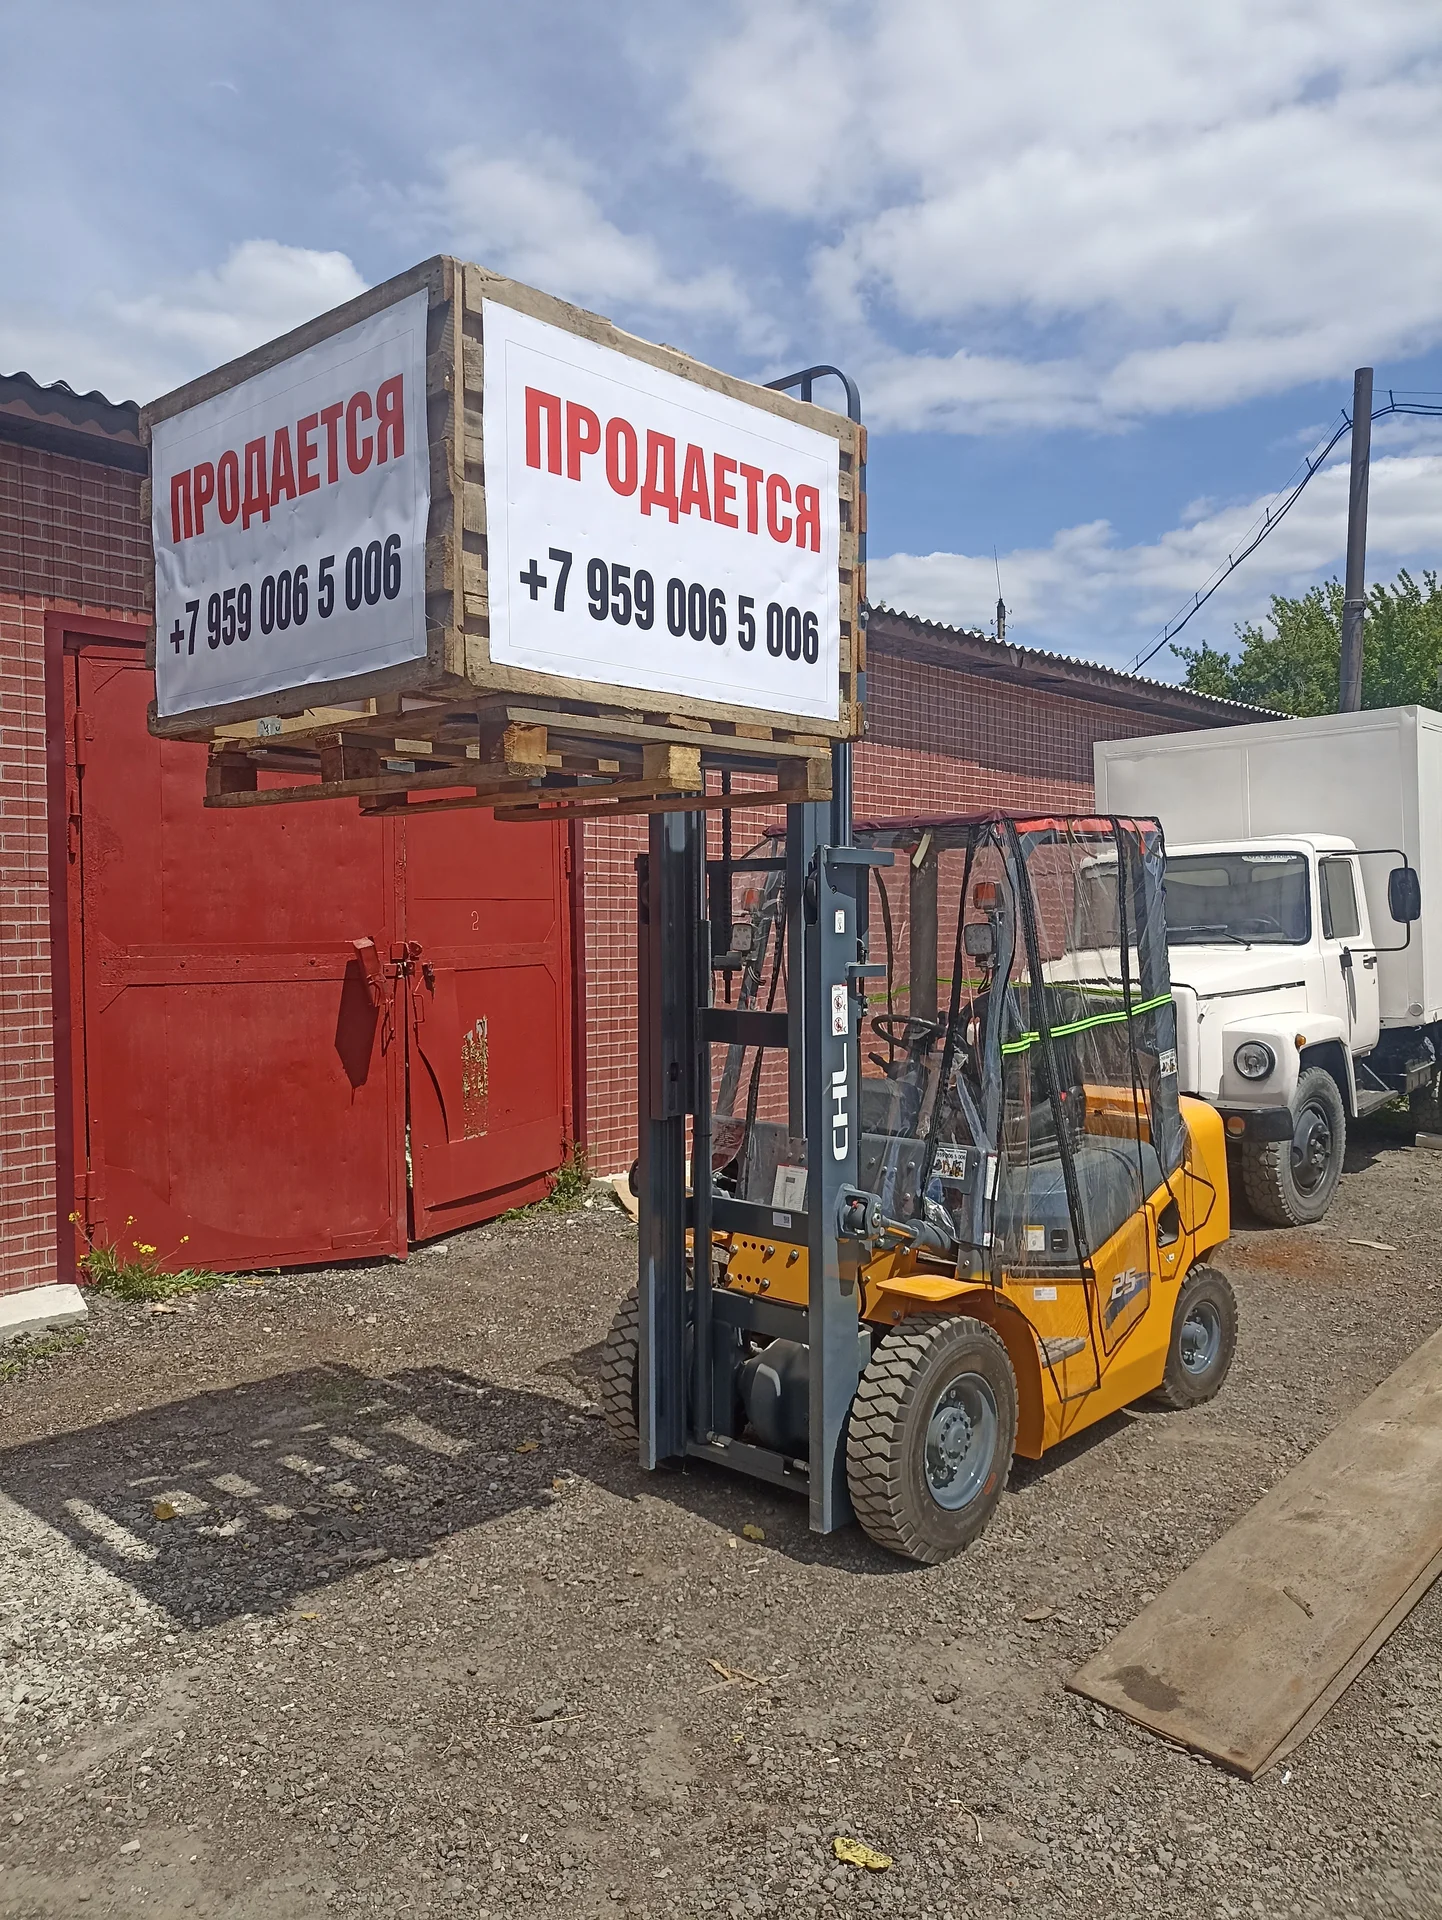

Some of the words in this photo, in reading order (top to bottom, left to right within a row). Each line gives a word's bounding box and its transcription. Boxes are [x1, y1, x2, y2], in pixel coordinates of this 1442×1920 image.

[171, 373, 404, 543] ПРОДАЕТСЯ
[525, 386, 820, 553] ПРОДАЕТСЯ
[170, 600, 200, 655] +7
[207, 582, 251, 650] 959
[260, 565, 307, 635] 006
[317, 555, 335, 619] 5
[345, 533, 401, 611] 006
[519, 547, 573, 612] +7
[587, 557, 654, 630] 959
[666, 578, 727, 646] 006
[738, 595, 756, 651] 5
[766, 602, 819, 664] 006
[471, 910, 479, 930] 2
[832, 1042, 848, 1160] CHL
[1111, 1266, 1137, 1300] 25
